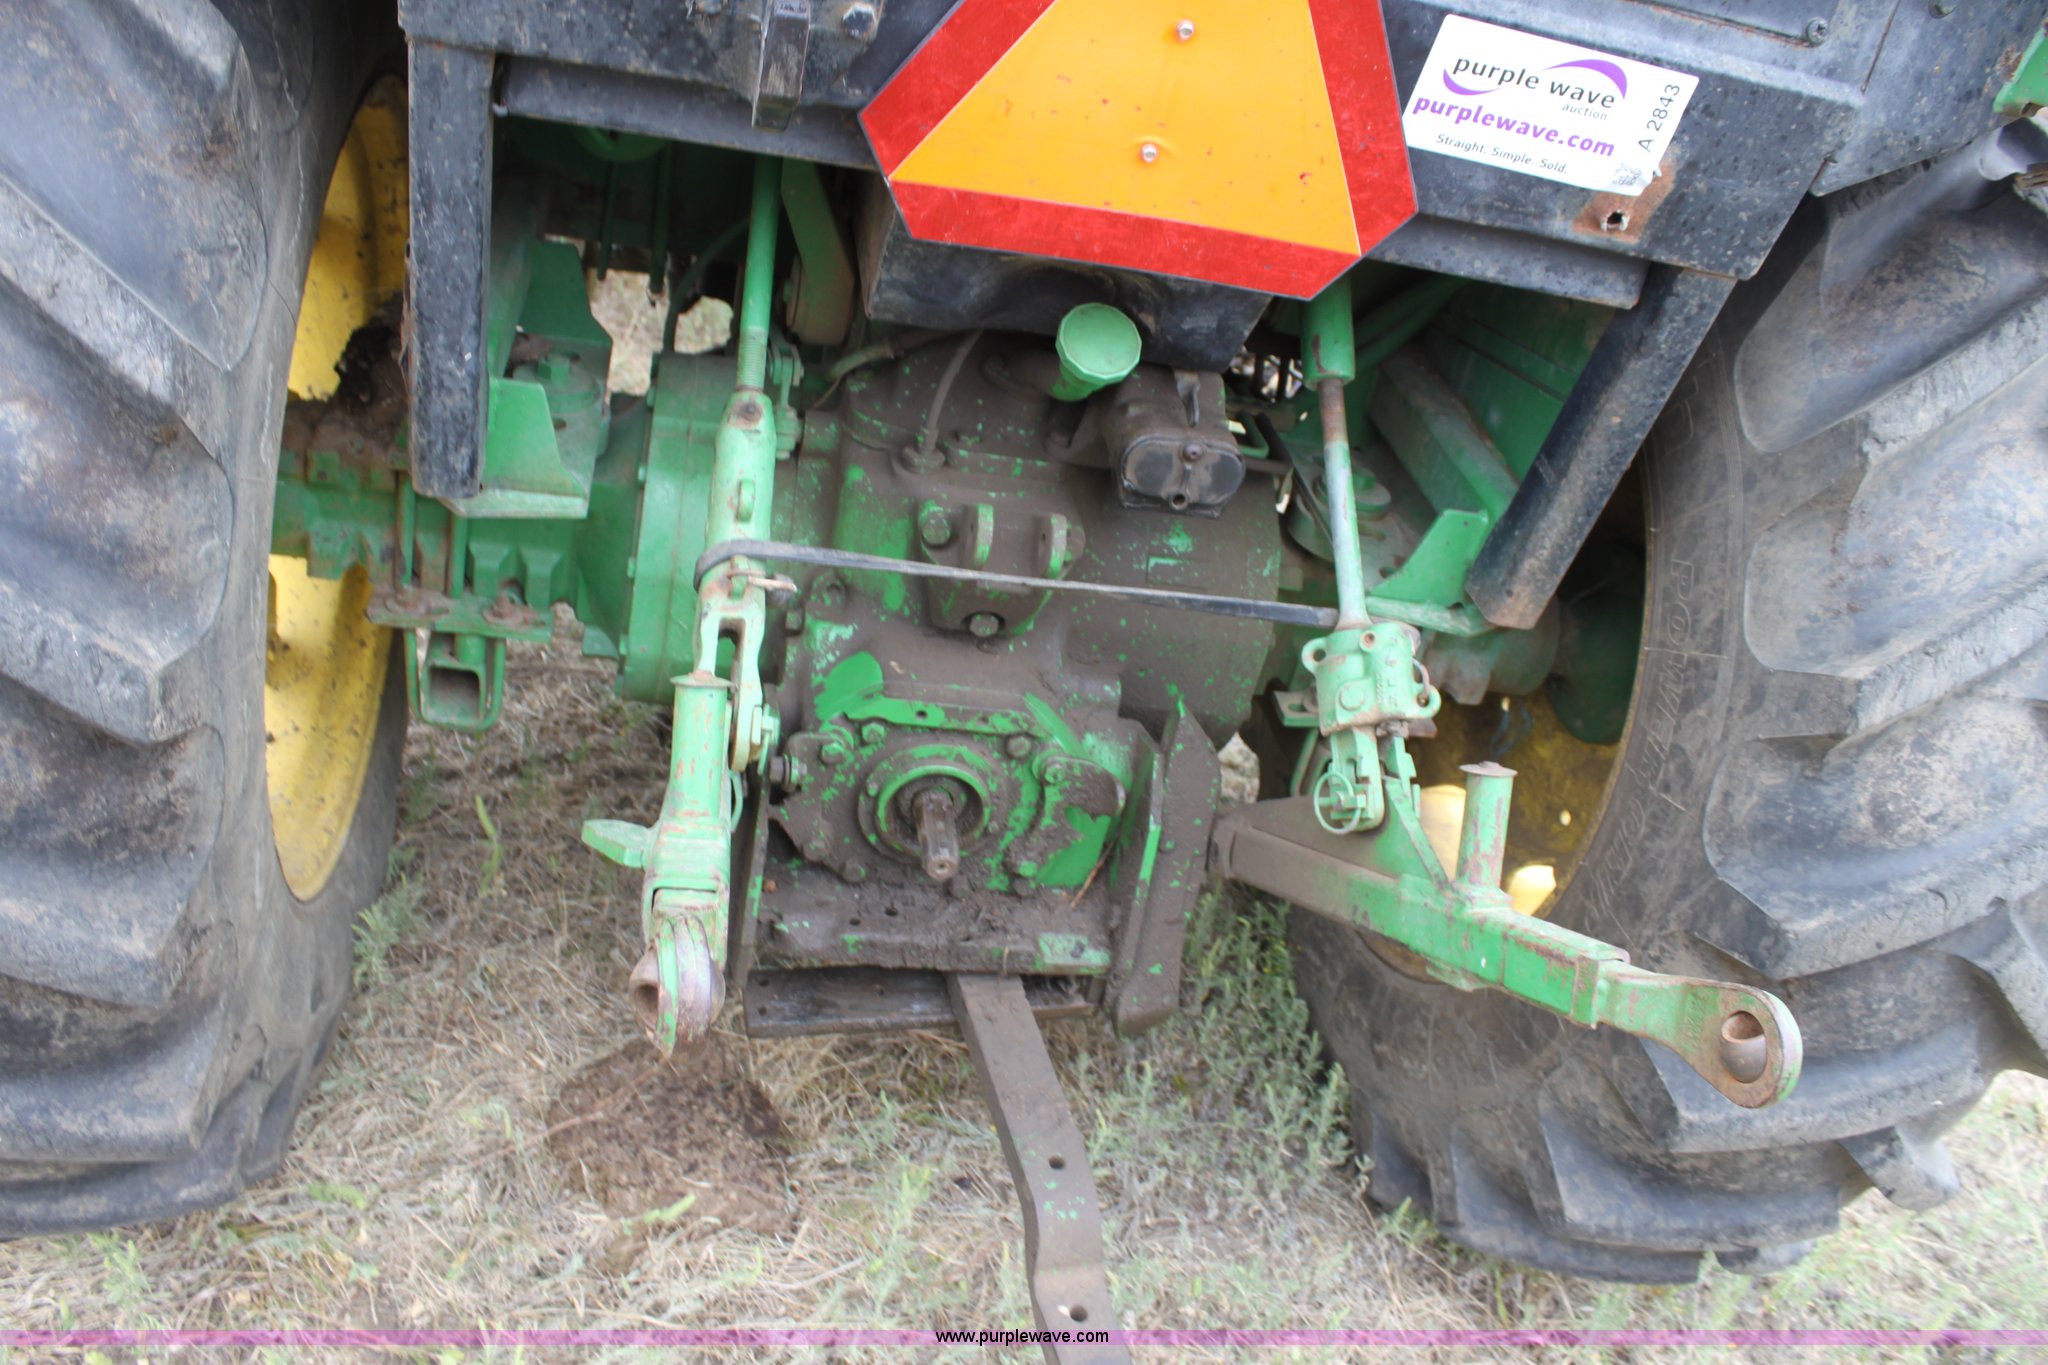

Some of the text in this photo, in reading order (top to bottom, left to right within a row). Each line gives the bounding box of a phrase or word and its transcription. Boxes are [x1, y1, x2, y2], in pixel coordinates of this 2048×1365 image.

[1452, 57, 1616, 109] purple wave
[1412, 96, 1616, 157] purplewave.com
[1562, 103, 1608, 120] auction
[1638, 84, 1681, 153] A 2843
[1436, 133, 1568, 174] Straight. Simple. Sold.
